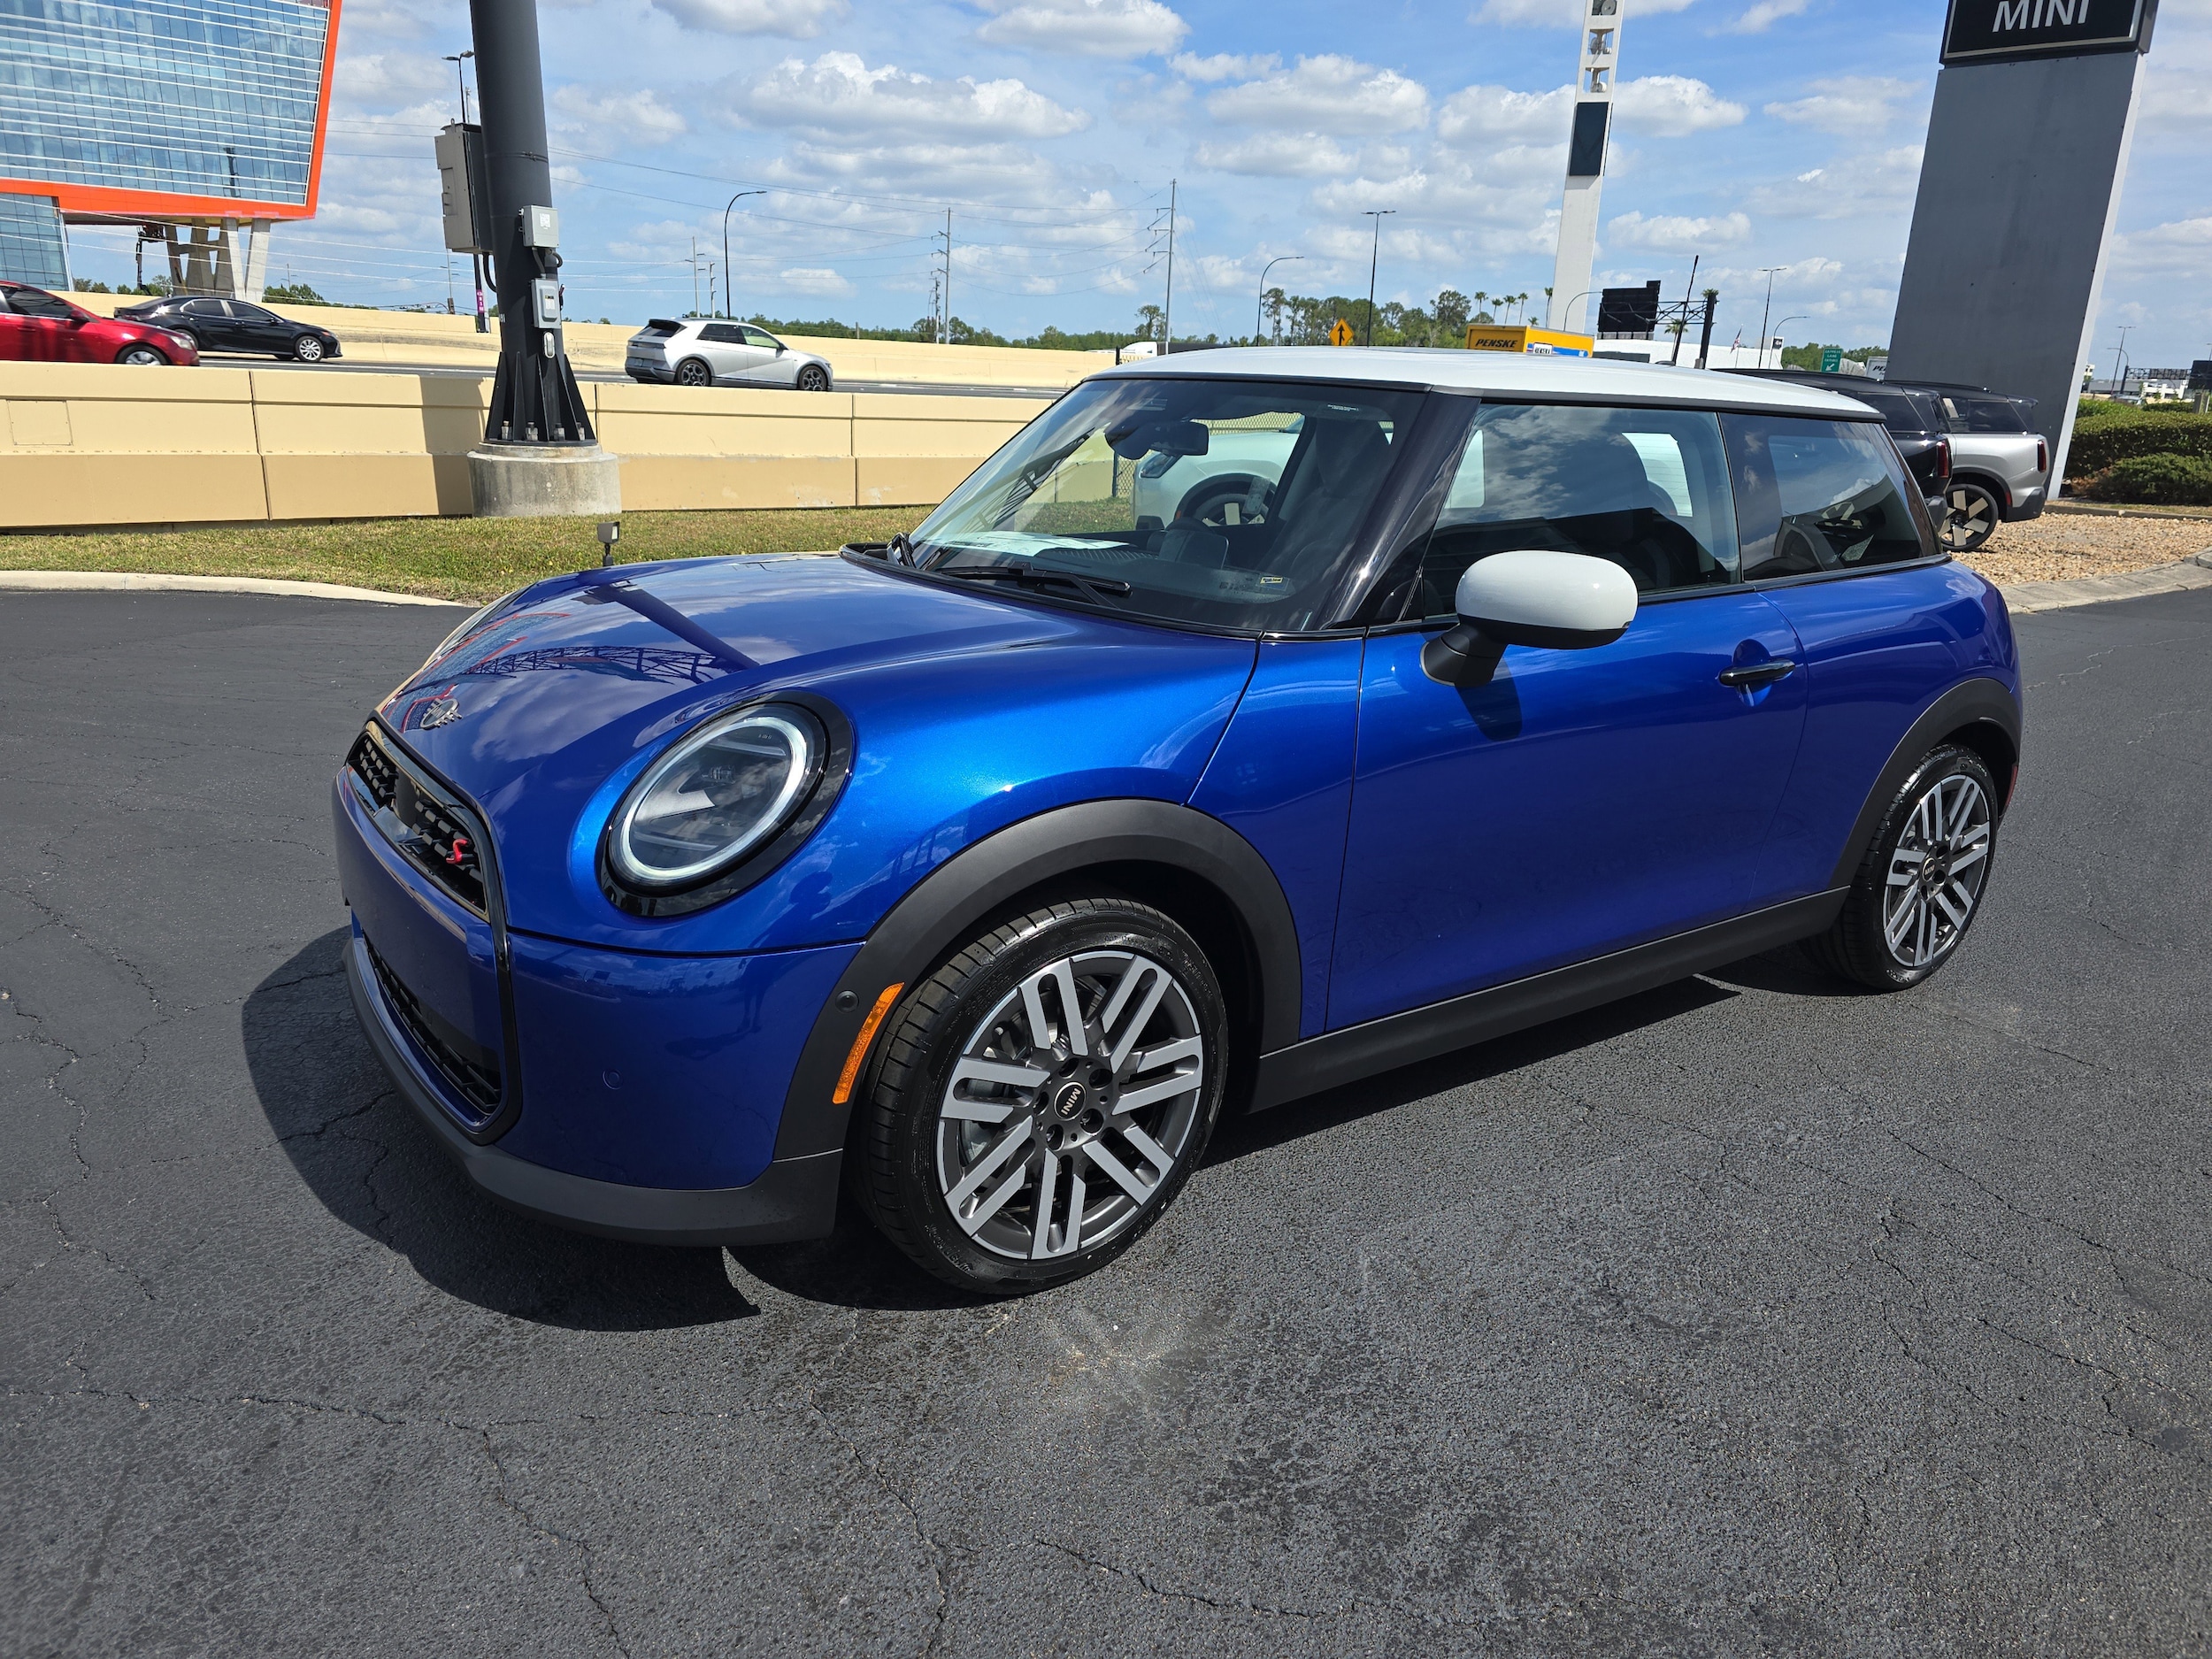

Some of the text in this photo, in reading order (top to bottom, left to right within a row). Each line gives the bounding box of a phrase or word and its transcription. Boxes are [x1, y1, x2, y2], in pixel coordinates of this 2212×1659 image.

[1992, 0, 2089, 32] MINI
[1475, 338, 1518, 348] PENSKE
[446, 838, 472, 865] S
[1061, 1087, 1081, 1116] MINI
